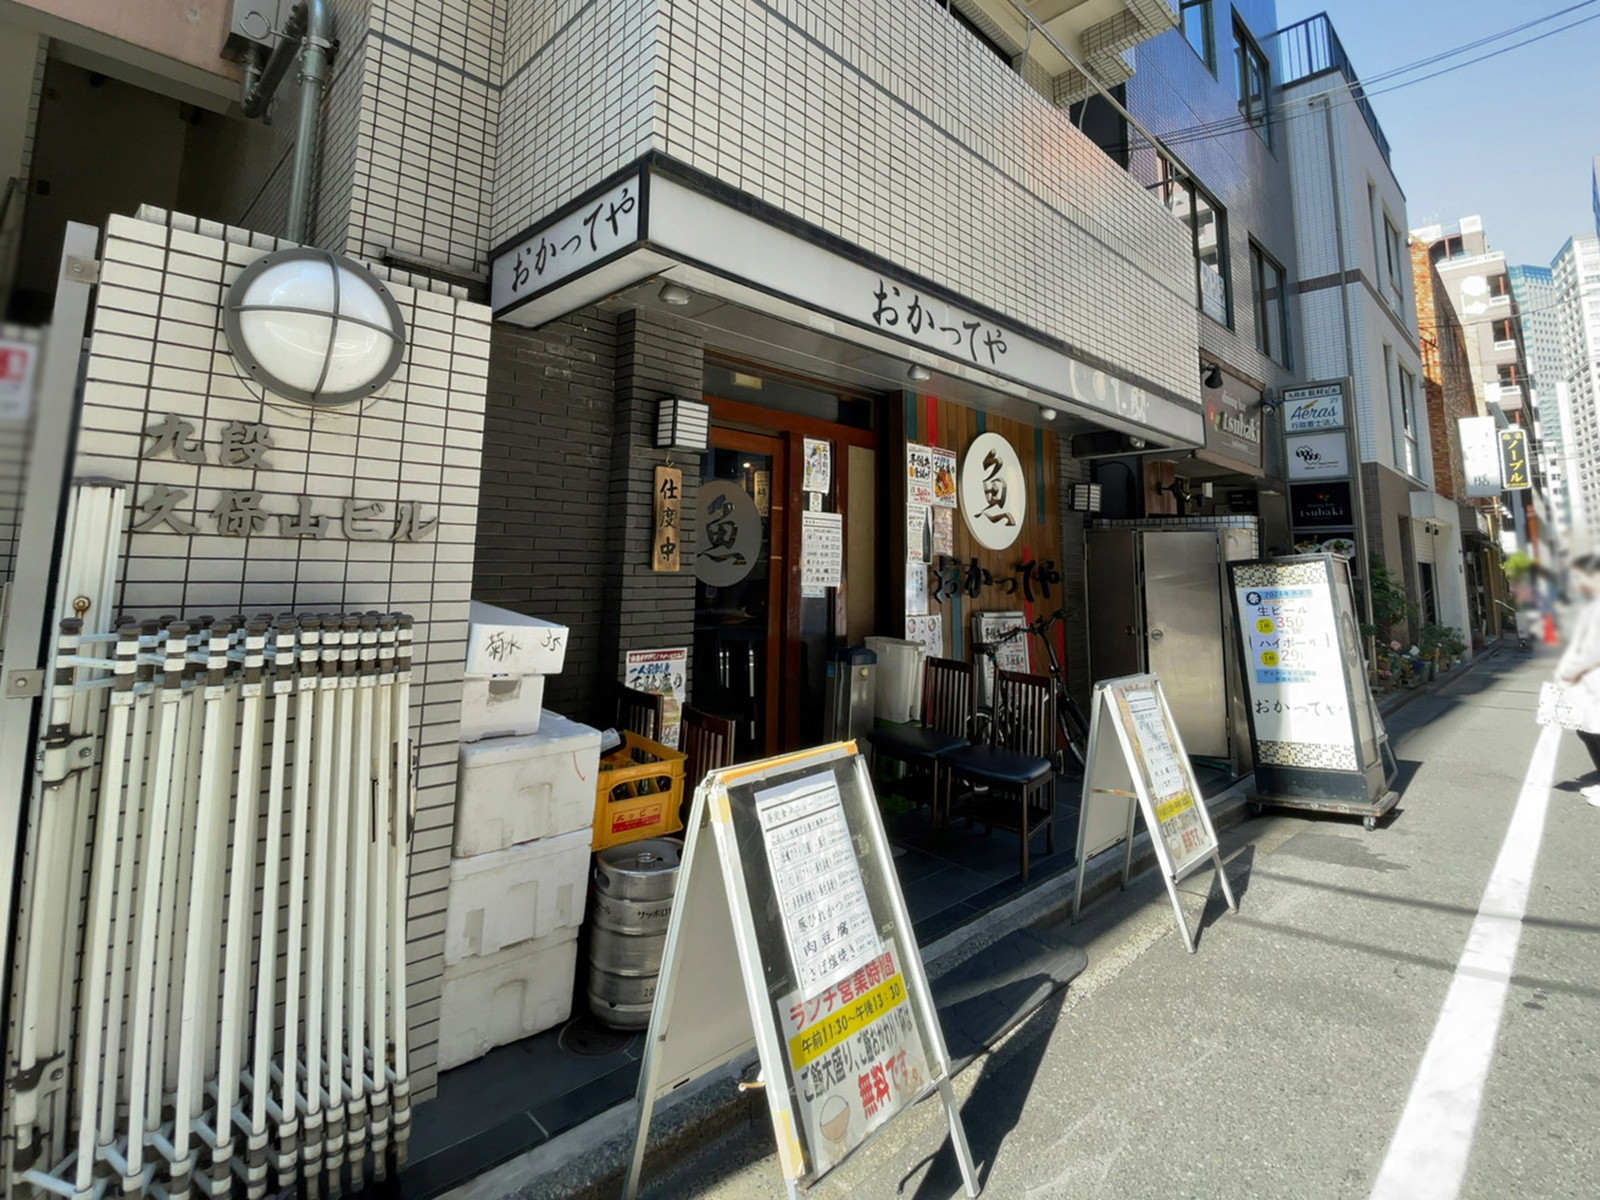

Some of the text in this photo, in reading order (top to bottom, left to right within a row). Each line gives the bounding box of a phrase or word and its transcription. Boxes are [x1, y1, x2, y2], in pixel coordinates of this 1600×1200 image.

[512, 188, 635, 292] おかってや
[872, 279, 1007, 364] おかってや
[1223, 411, 1260, 443] tsubaki
[1290, 405, 1337, 420] Aeras
[144, 411, 275, 470] 九段
[1506, 440, 1524, 483] ノーブル
[973, 447, 1016, 527] 魚
[131, 484, 438, 541] 久保山ビル
[660, 478, 679, 562] 仕度中
[696, 494, 747, 566] 魚
[1300, 507, 1343, 517] tsubaki
[933, 555, 1060, 604] おかってや
[1257, 606, 1308, 617] 生ビール
[485, 631, 522, 662] 菊水
[1260, 638, 1317, 649] ハイボール
[803, 921, 849, 956] 肉豆腐
[809, 944, 855, 981] さば塩焼き
[789, 951, 896, 1031] ランチ営業時間
